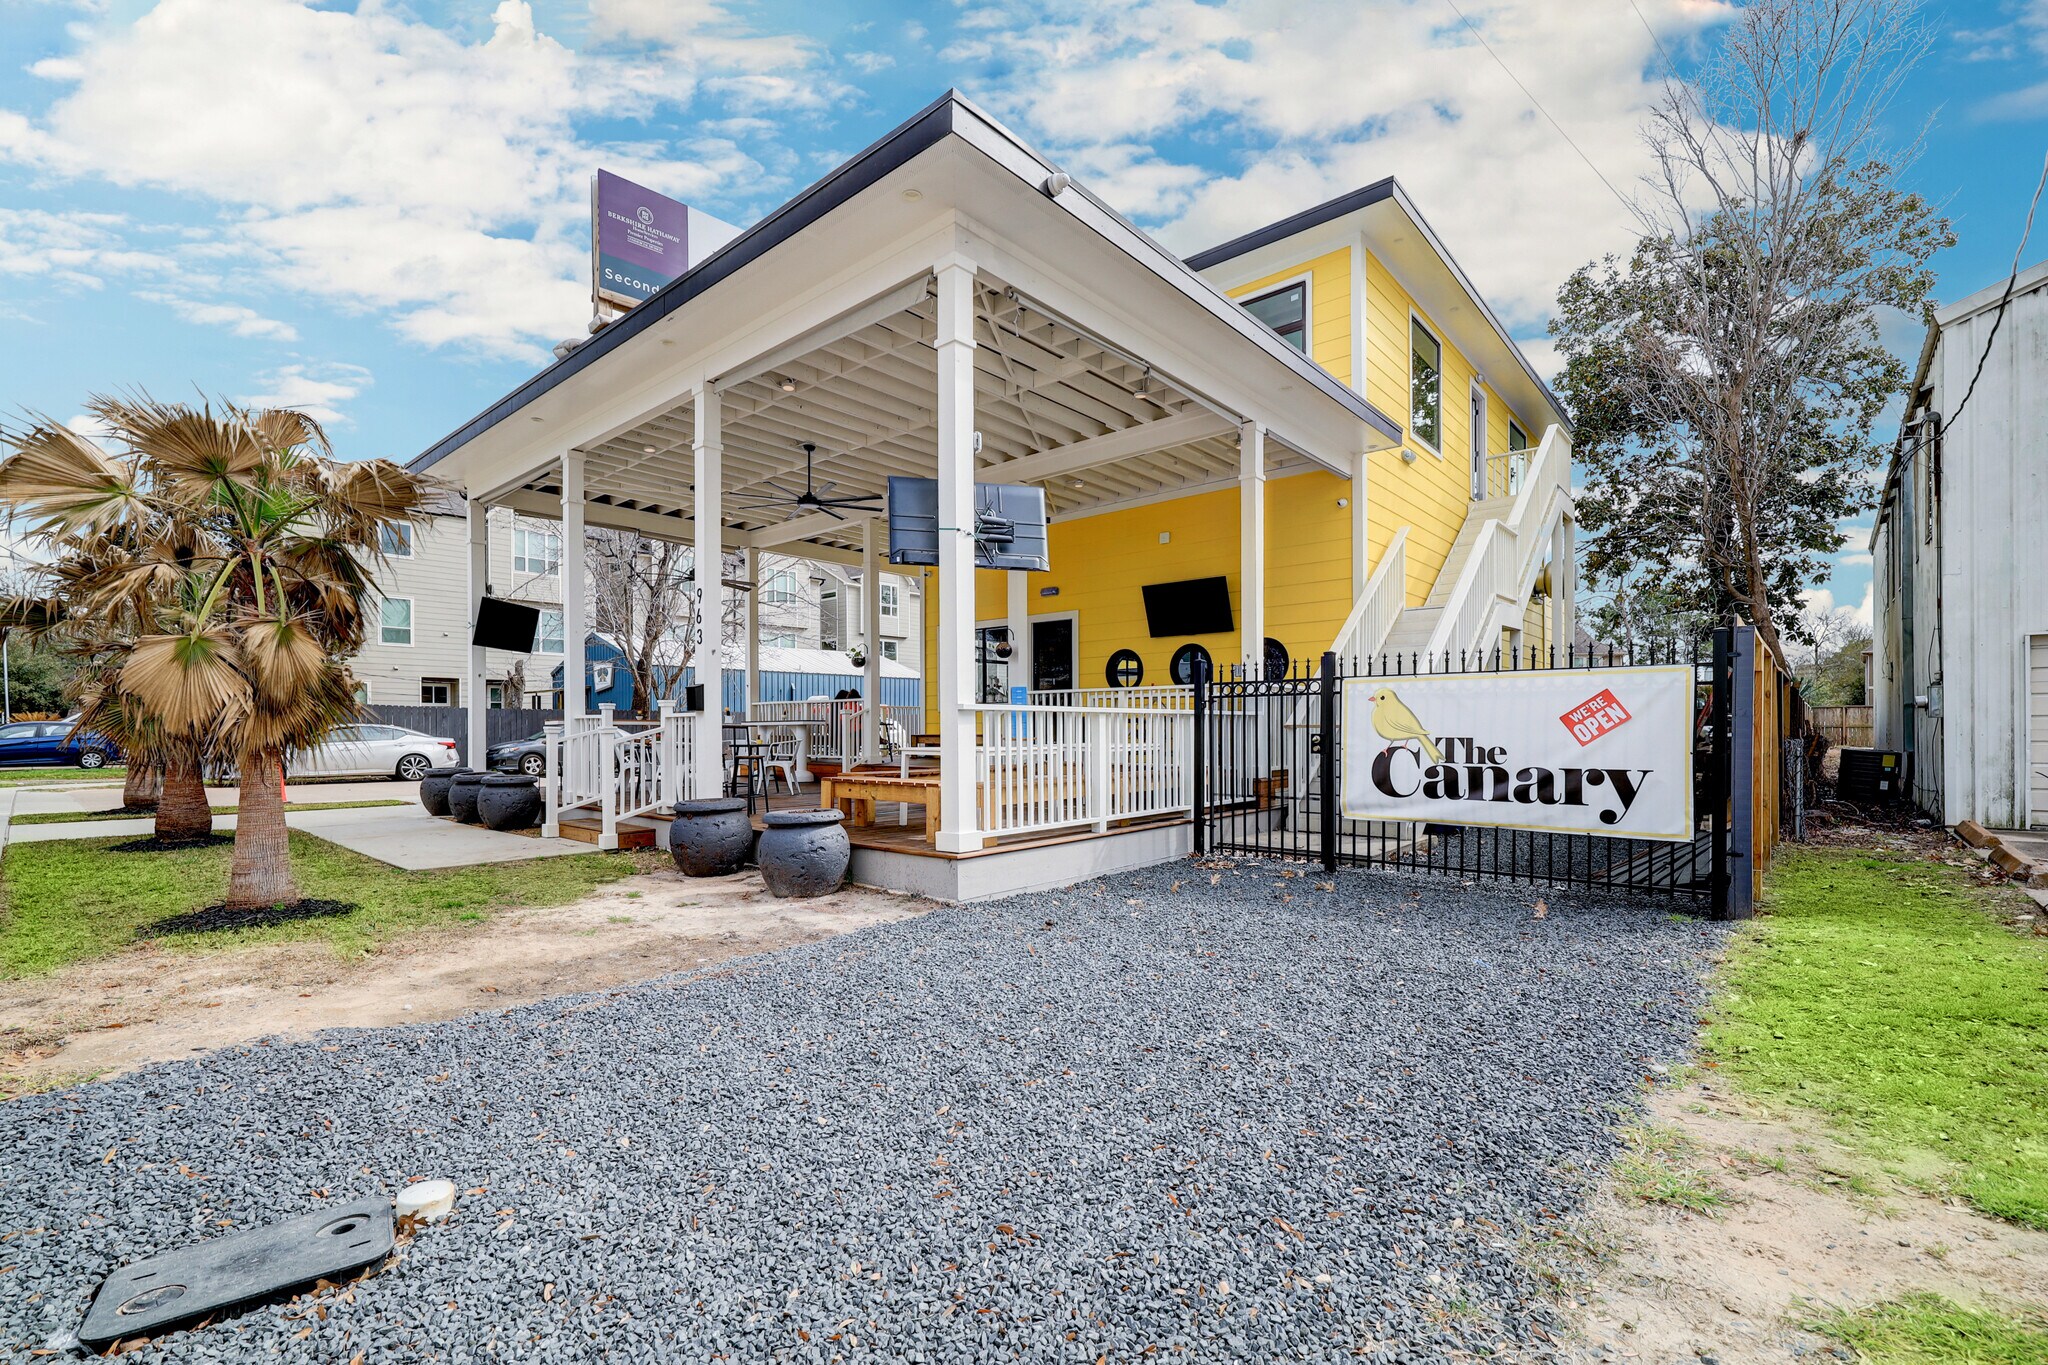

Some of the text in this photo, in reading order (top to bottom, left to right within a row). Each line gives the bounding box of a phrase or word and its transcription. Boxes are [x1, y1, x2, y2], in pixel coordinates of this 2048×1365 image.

[607, 210, 647, 231] BERKSHIRE
[647, 226, 680, 244] HATHAWAY
[1568, 695, 1608, 723] WE'RE
[1572, 702, 1628, 743] OPEN
[1435, 736, 1508, 765] The
[1371, 745, 1654, 825] Canary
